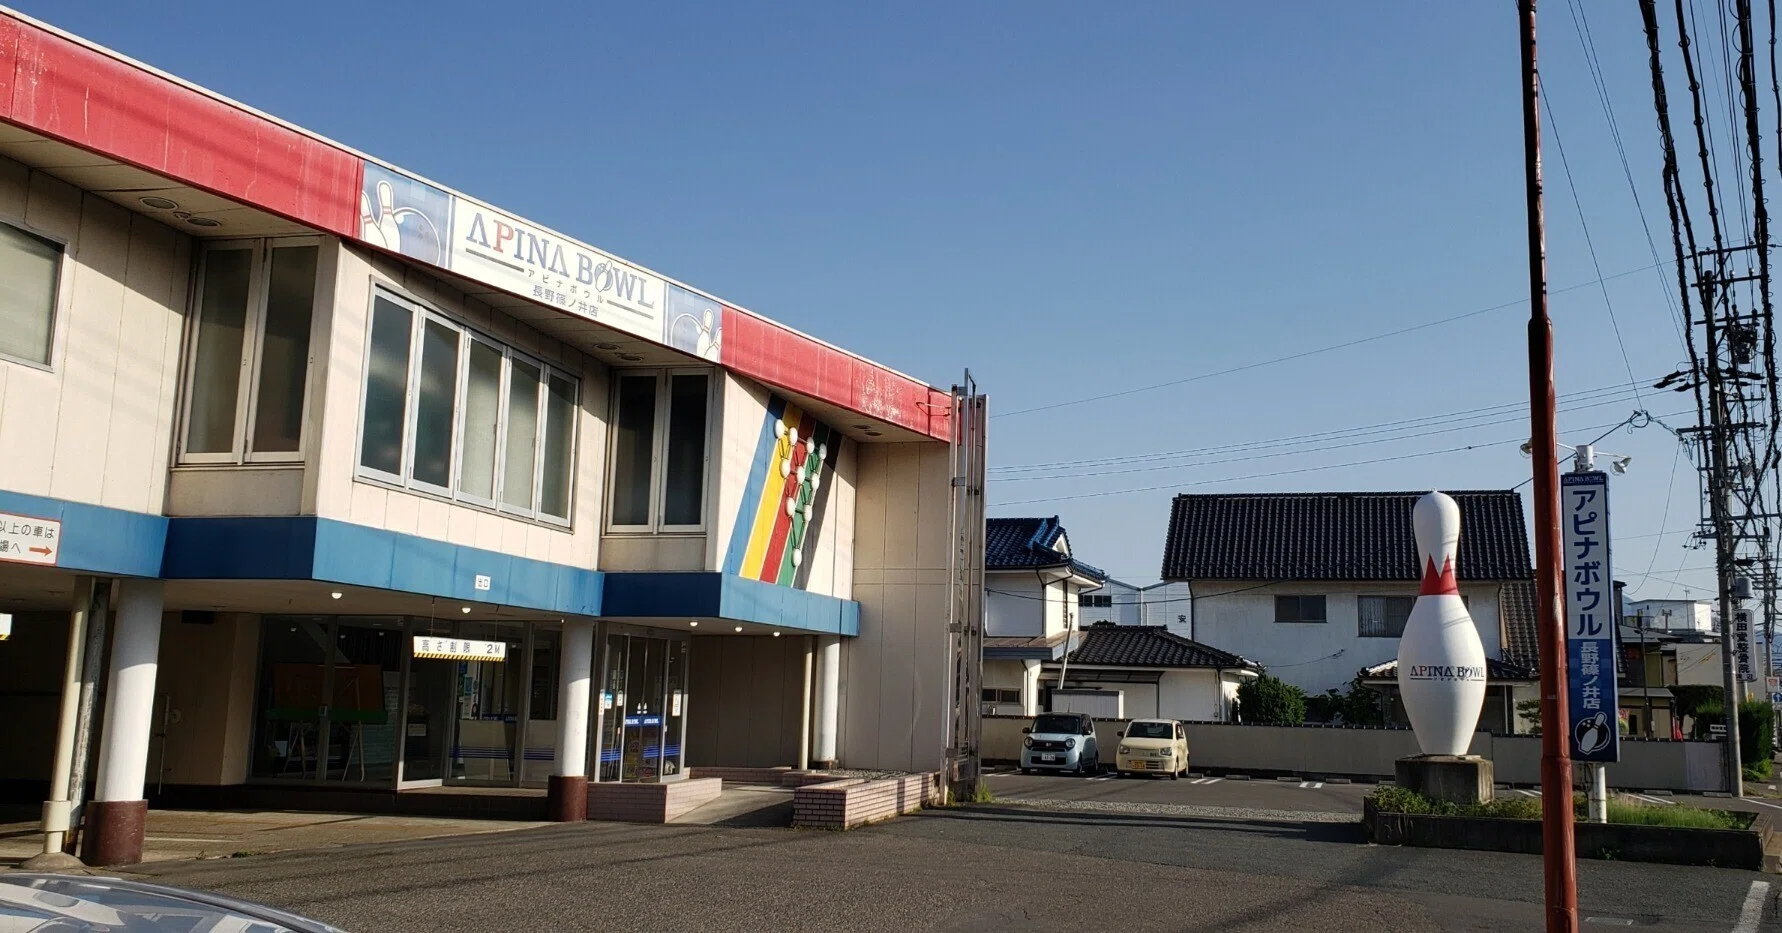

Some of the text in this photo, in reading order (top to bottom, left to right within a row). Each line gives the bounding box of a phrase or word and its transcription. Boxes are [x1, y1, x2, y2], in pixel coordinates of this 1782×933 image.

[466, 212, 655, 309] APINA BOWL
[527, 268, 604, 303] アピナボウル
[532, 284, 599, 317] 長野篠ノ井店
[0, 520, 55, 539] 以上の車は
[1572, 489, 1603, 637] アピナボウル
[1410, 665, 1485, 678] APINA BOWL
[1581, 641, 1601, 710] 長野篠ノ井店
